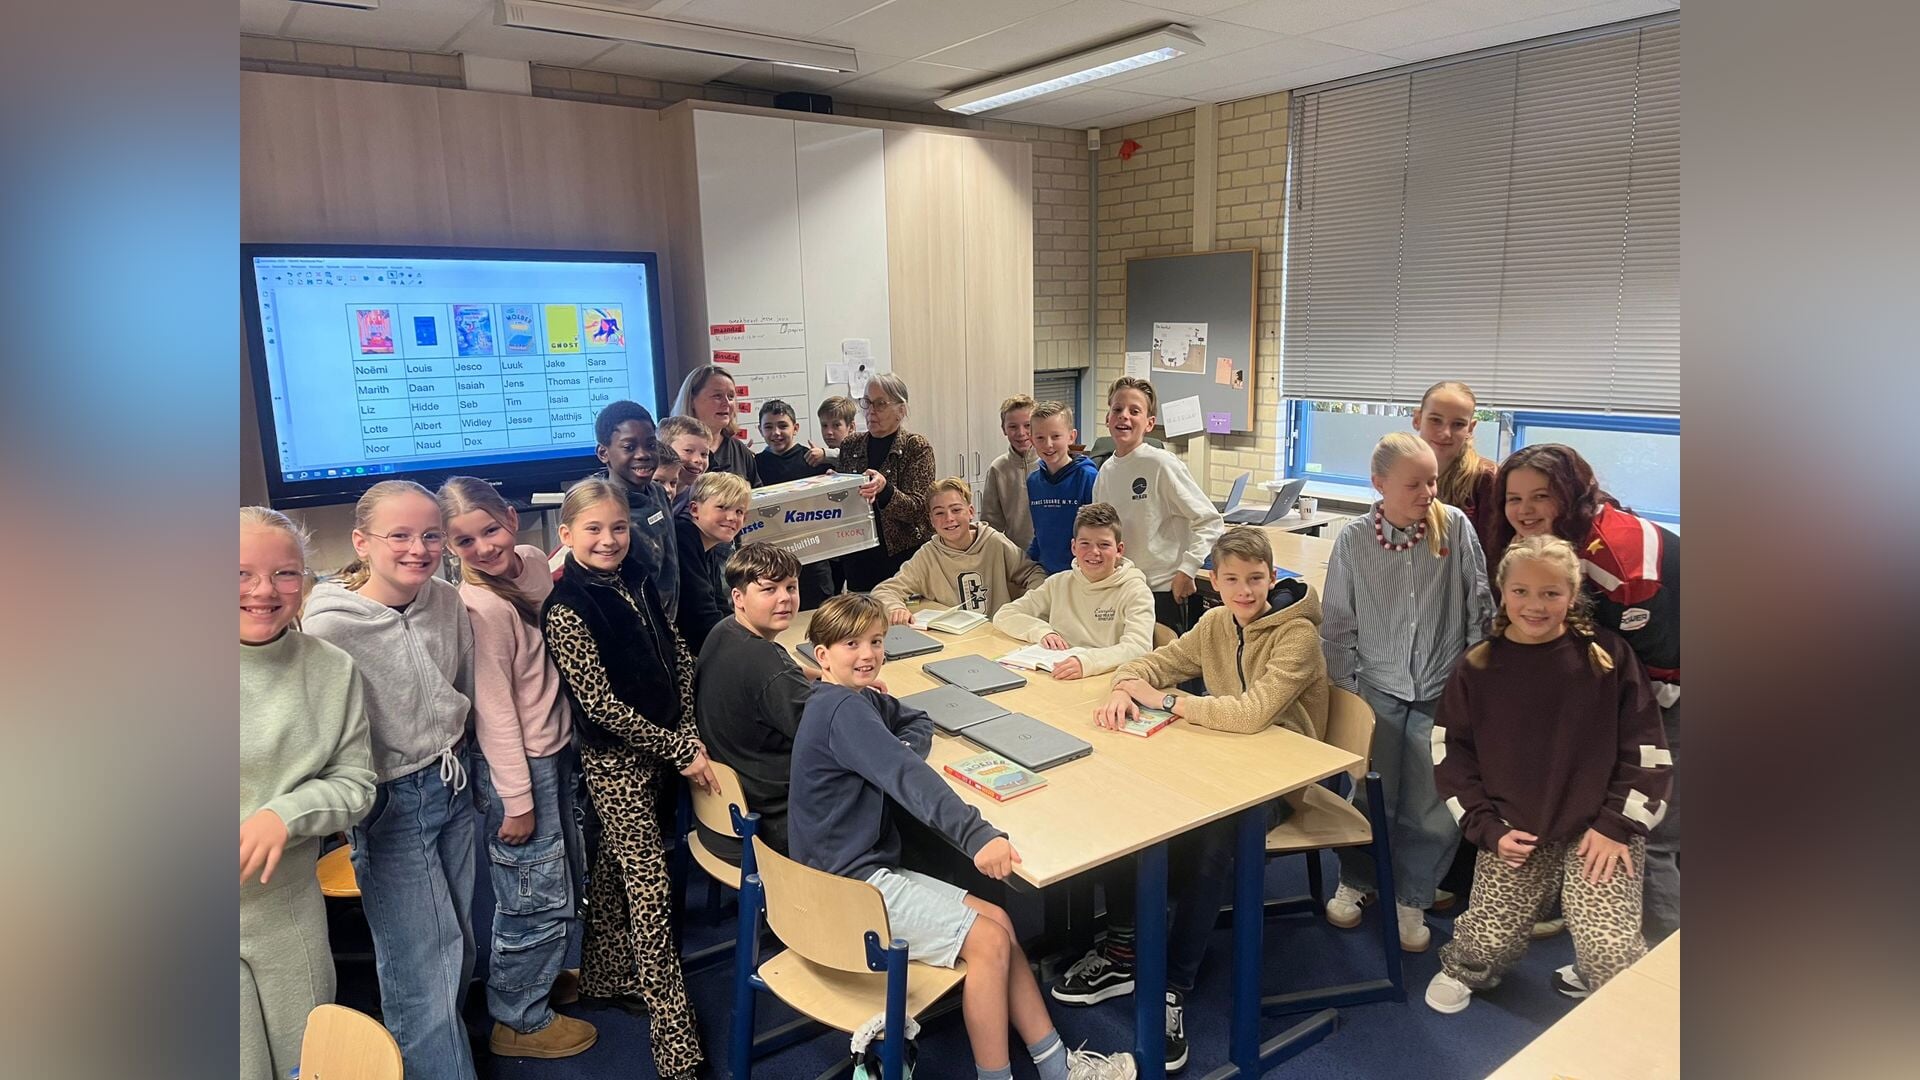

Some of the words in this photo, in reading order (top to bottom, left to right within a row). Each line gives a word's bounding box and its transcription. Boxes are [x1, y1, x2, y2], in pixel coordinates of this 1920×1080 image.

[502, 361, 523, 370] Luuk
[546, 360, 565, 368] Jake
[587, 358, 606, 366] Sara
[355, 365, 388, 375] Noëmi
[407, 364, 433, 373] Louis
[455, 363, 482, 371] Jesco
[504, 380, 524, 388] Jens
[548, 376, 581, 386] Thomas
[589, 375, 613, 384] Feline
[358, 385, 389, 395] Marith
[409, 383, 435, 392] Daan
[458, 381, 485, 390] Isaiah
[506, 397, 522, 406] Tim
[549, 395, 569, 404] Isaia
[591, 392, 609, 402] Julia
[411, 402, 439, 412] Hidde
[460, 400, 478, 409] Seb
[361, 406, 376, 415] Liz
[507, 415, 533, 425] Jesse
[551, 412, 582, 422] Matthijs
[414, 421, 442, 431] Albert
[462, 418, 492, 428] Widley
[363, 425, 389, 434] Lotte
[416, 439, 442, 449] Naud
[464, 437, 482, 446] Dex
[366, 444, 390, 453] Noor
[784, 508, 841, 523] Kansen
